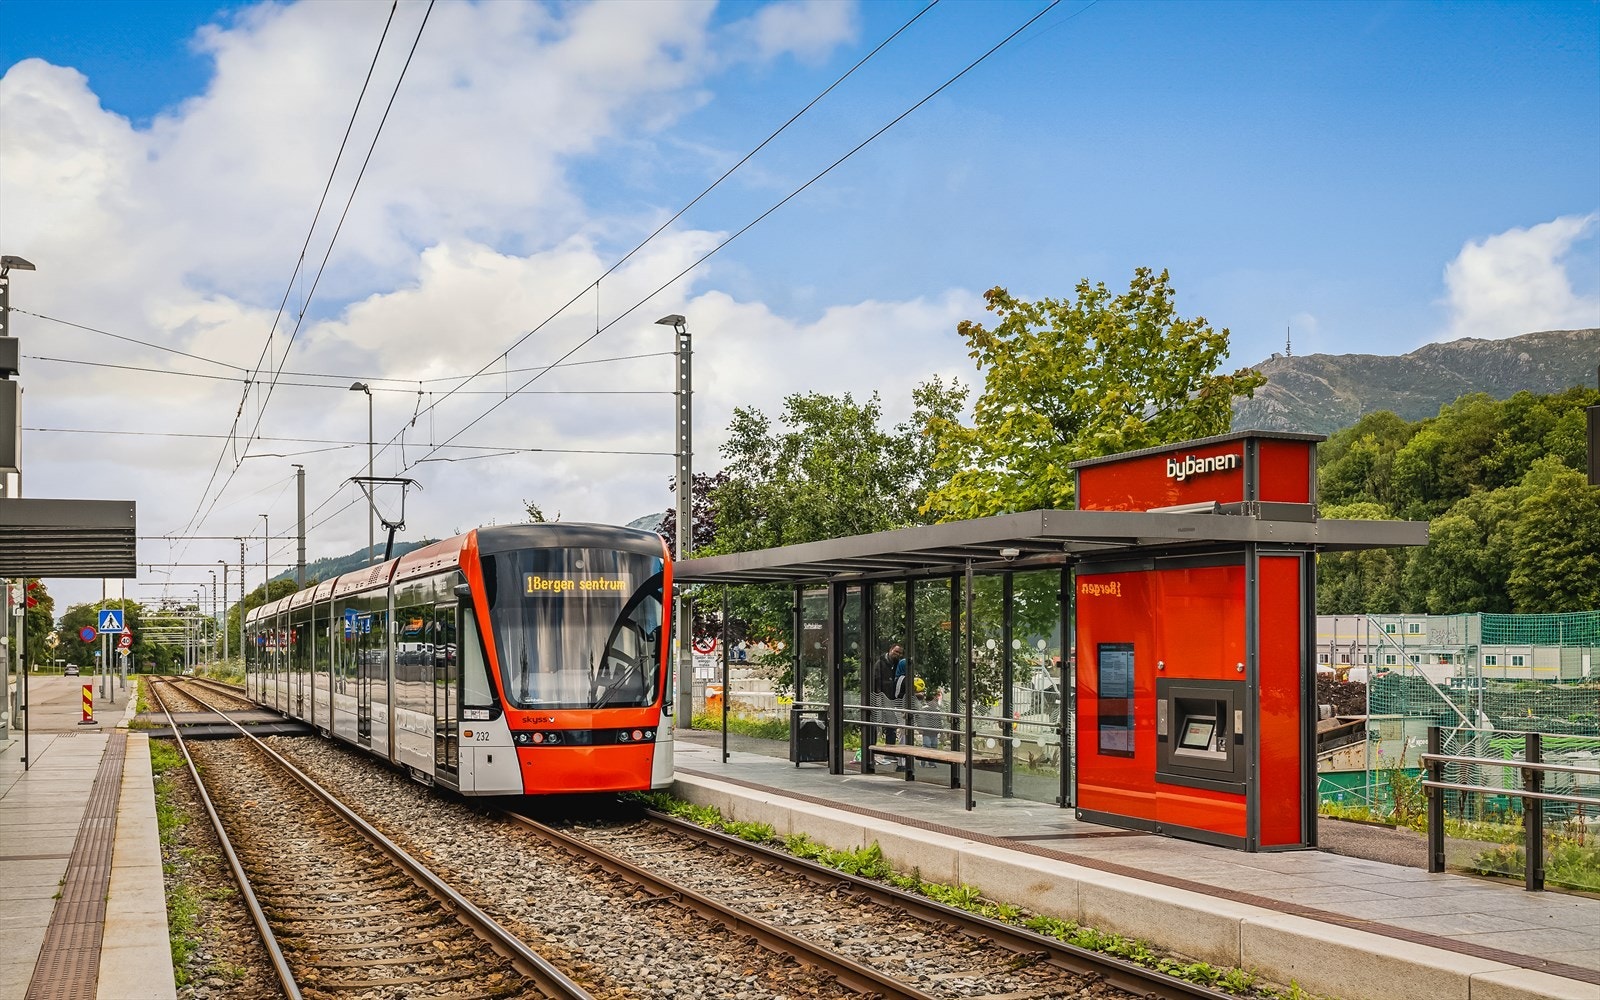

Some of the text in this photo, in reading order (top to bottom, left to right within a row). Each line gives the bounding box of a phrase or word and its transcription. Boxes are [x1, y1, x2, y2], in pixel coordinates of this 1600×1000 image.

[1166, 453, 1236, 481] bybanen
[579, 577, 626, 591] sentrum
[522, 716, 548, 724] skyss
[476, 731, 490, 741] 232
